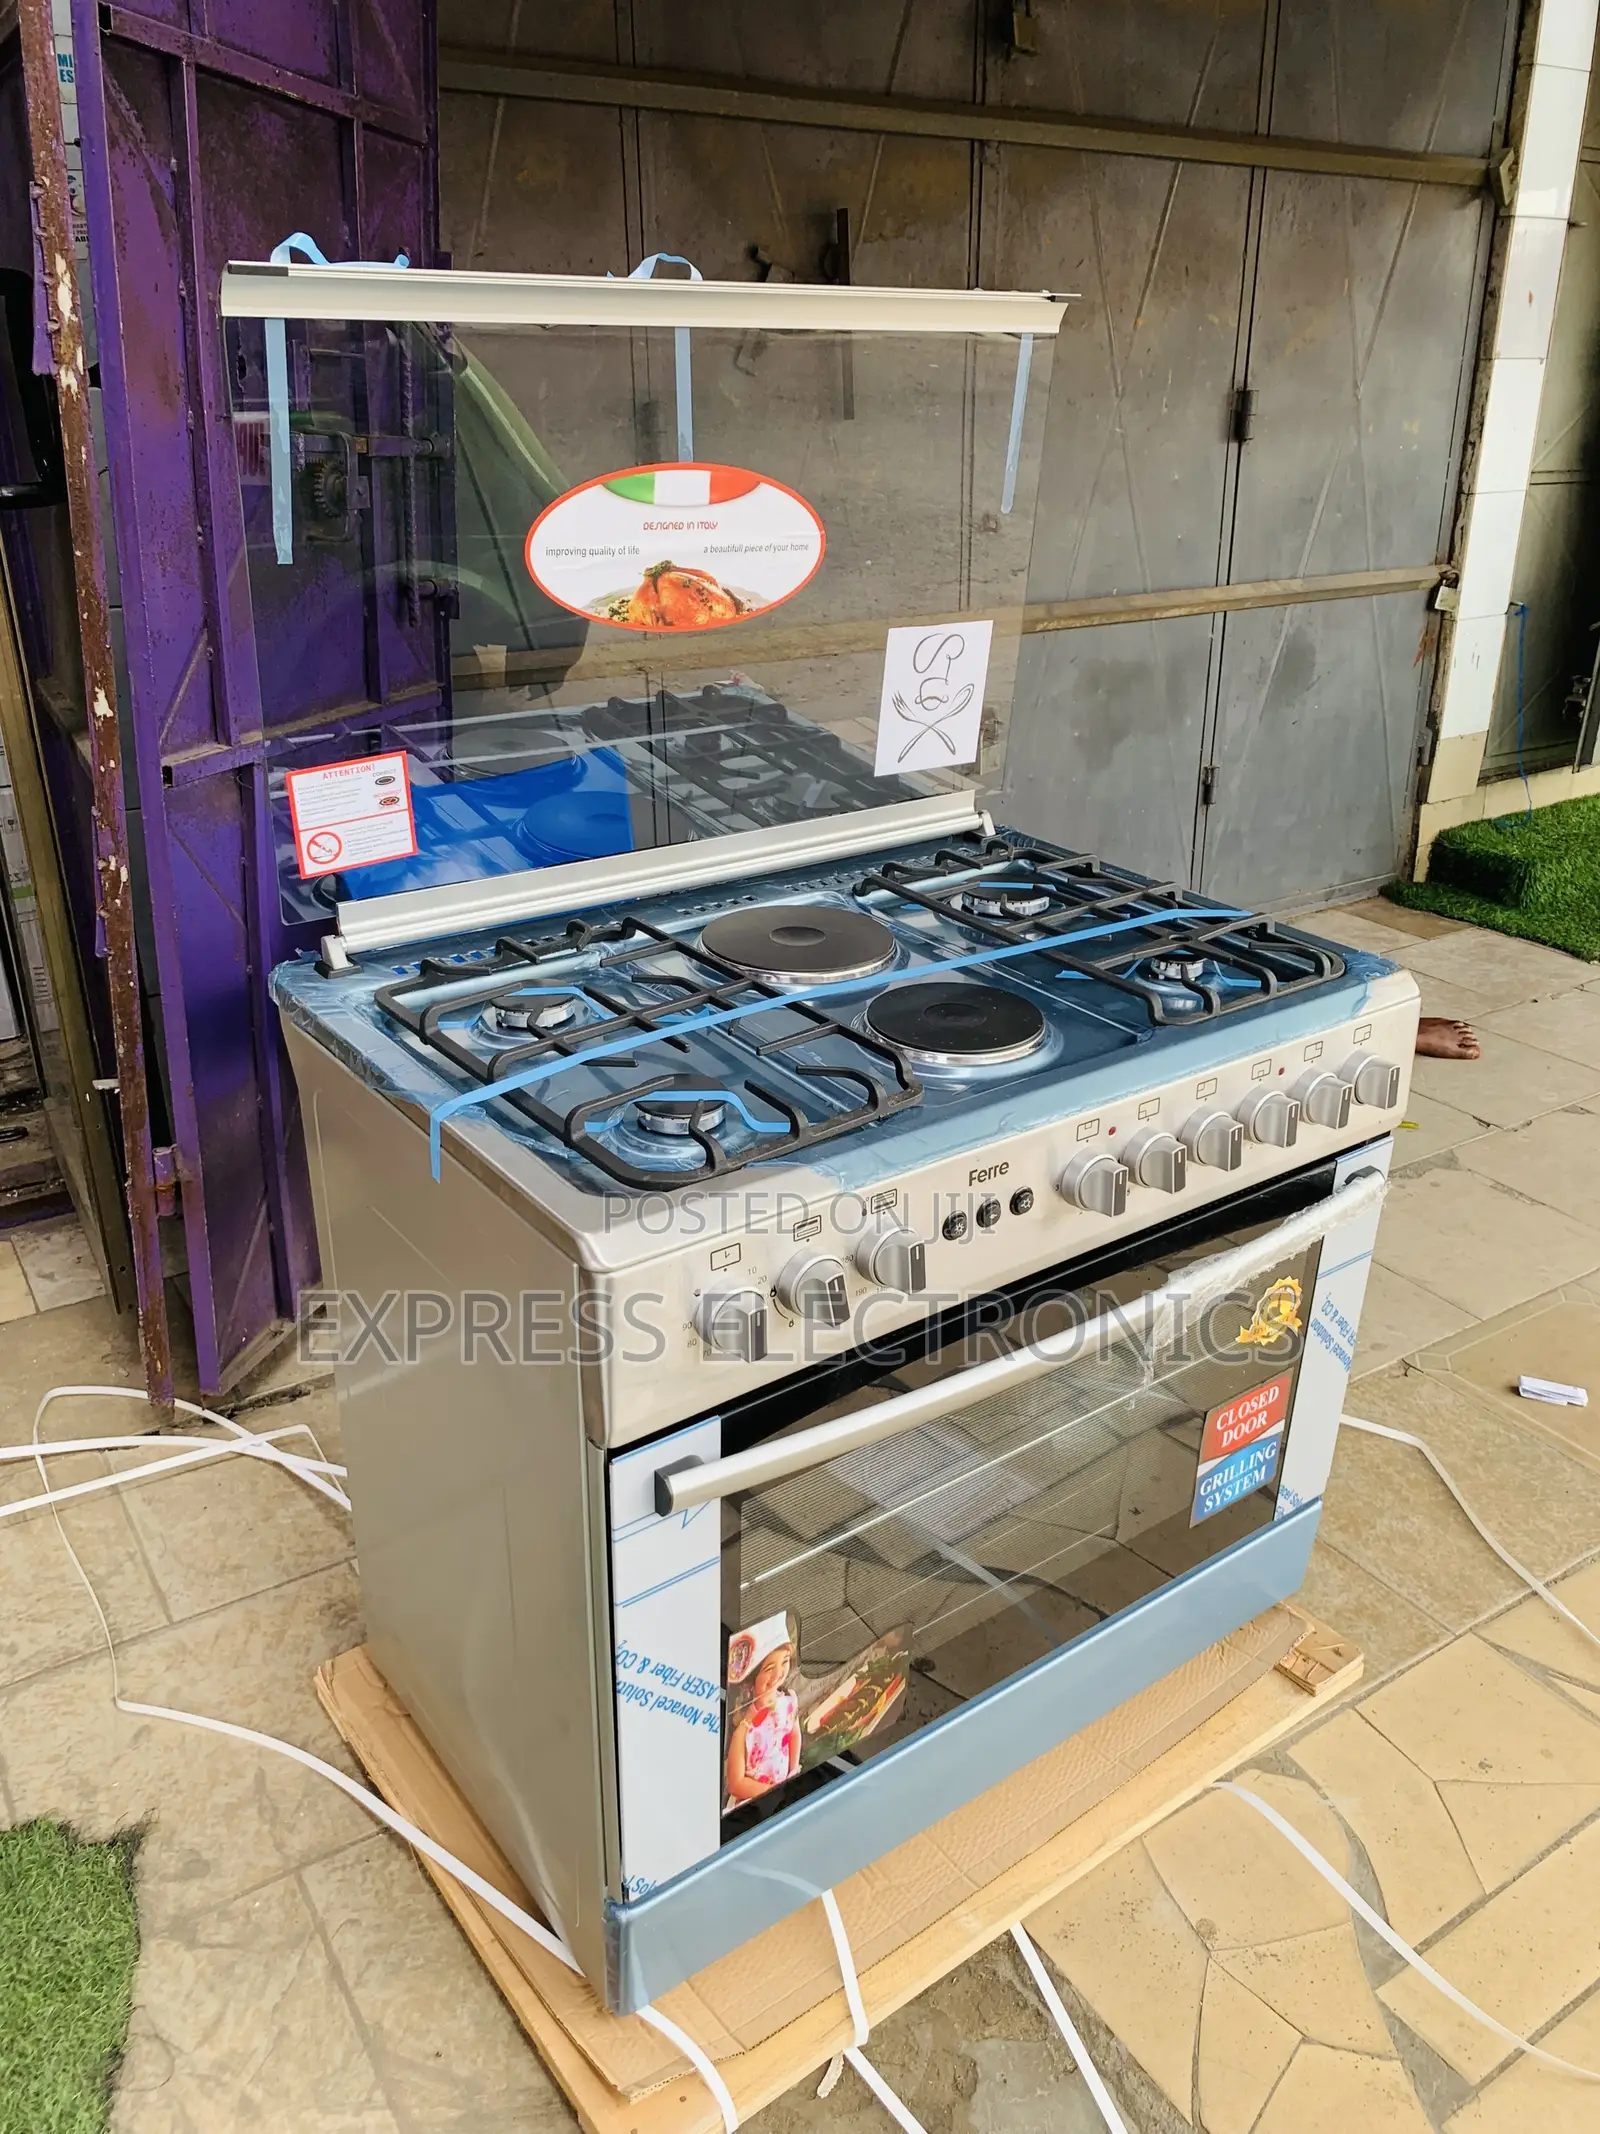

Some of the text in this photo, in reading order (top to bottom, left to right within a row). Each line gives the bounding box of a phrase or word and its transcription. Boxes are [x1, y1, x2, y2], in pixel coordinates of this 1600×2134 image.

[643, 521, 719, 531] DESIGNED IN ITALY
[545, 545, 640, 558] improving quality of life
[710, 544, 743, 553] beautifull
[744, 544, 763, 554] piece
[764, 543, 772, 552] of
[772, 544, 789, 554] your
[791, 543, 808, 551] home
[323, 764, 375, 780] ATTENTION!
[968, 1161, 1009, 1187] Ferre
[757, 1275, 767, 1285] 20
[682, 1321, 693, 1332] 90
[1310, 1317, 1334, 1350] Solution
[687, 1339, 697, 1348] 80
[1216, 1385, 1280, 1431] CLOSED
[1221, 1410, 1268, 1448] DOOR
[1200, 1441, 1277, 1496] GRILLING
[1204, 1464, 1267, 1513] SYSTEM
[636, 1656, 651, 1674] &
[649, 1661, 685, 1688] Fiber
[649, 1694, 704, 1726] Novacel
[702, 1712, 720, 1733] The
